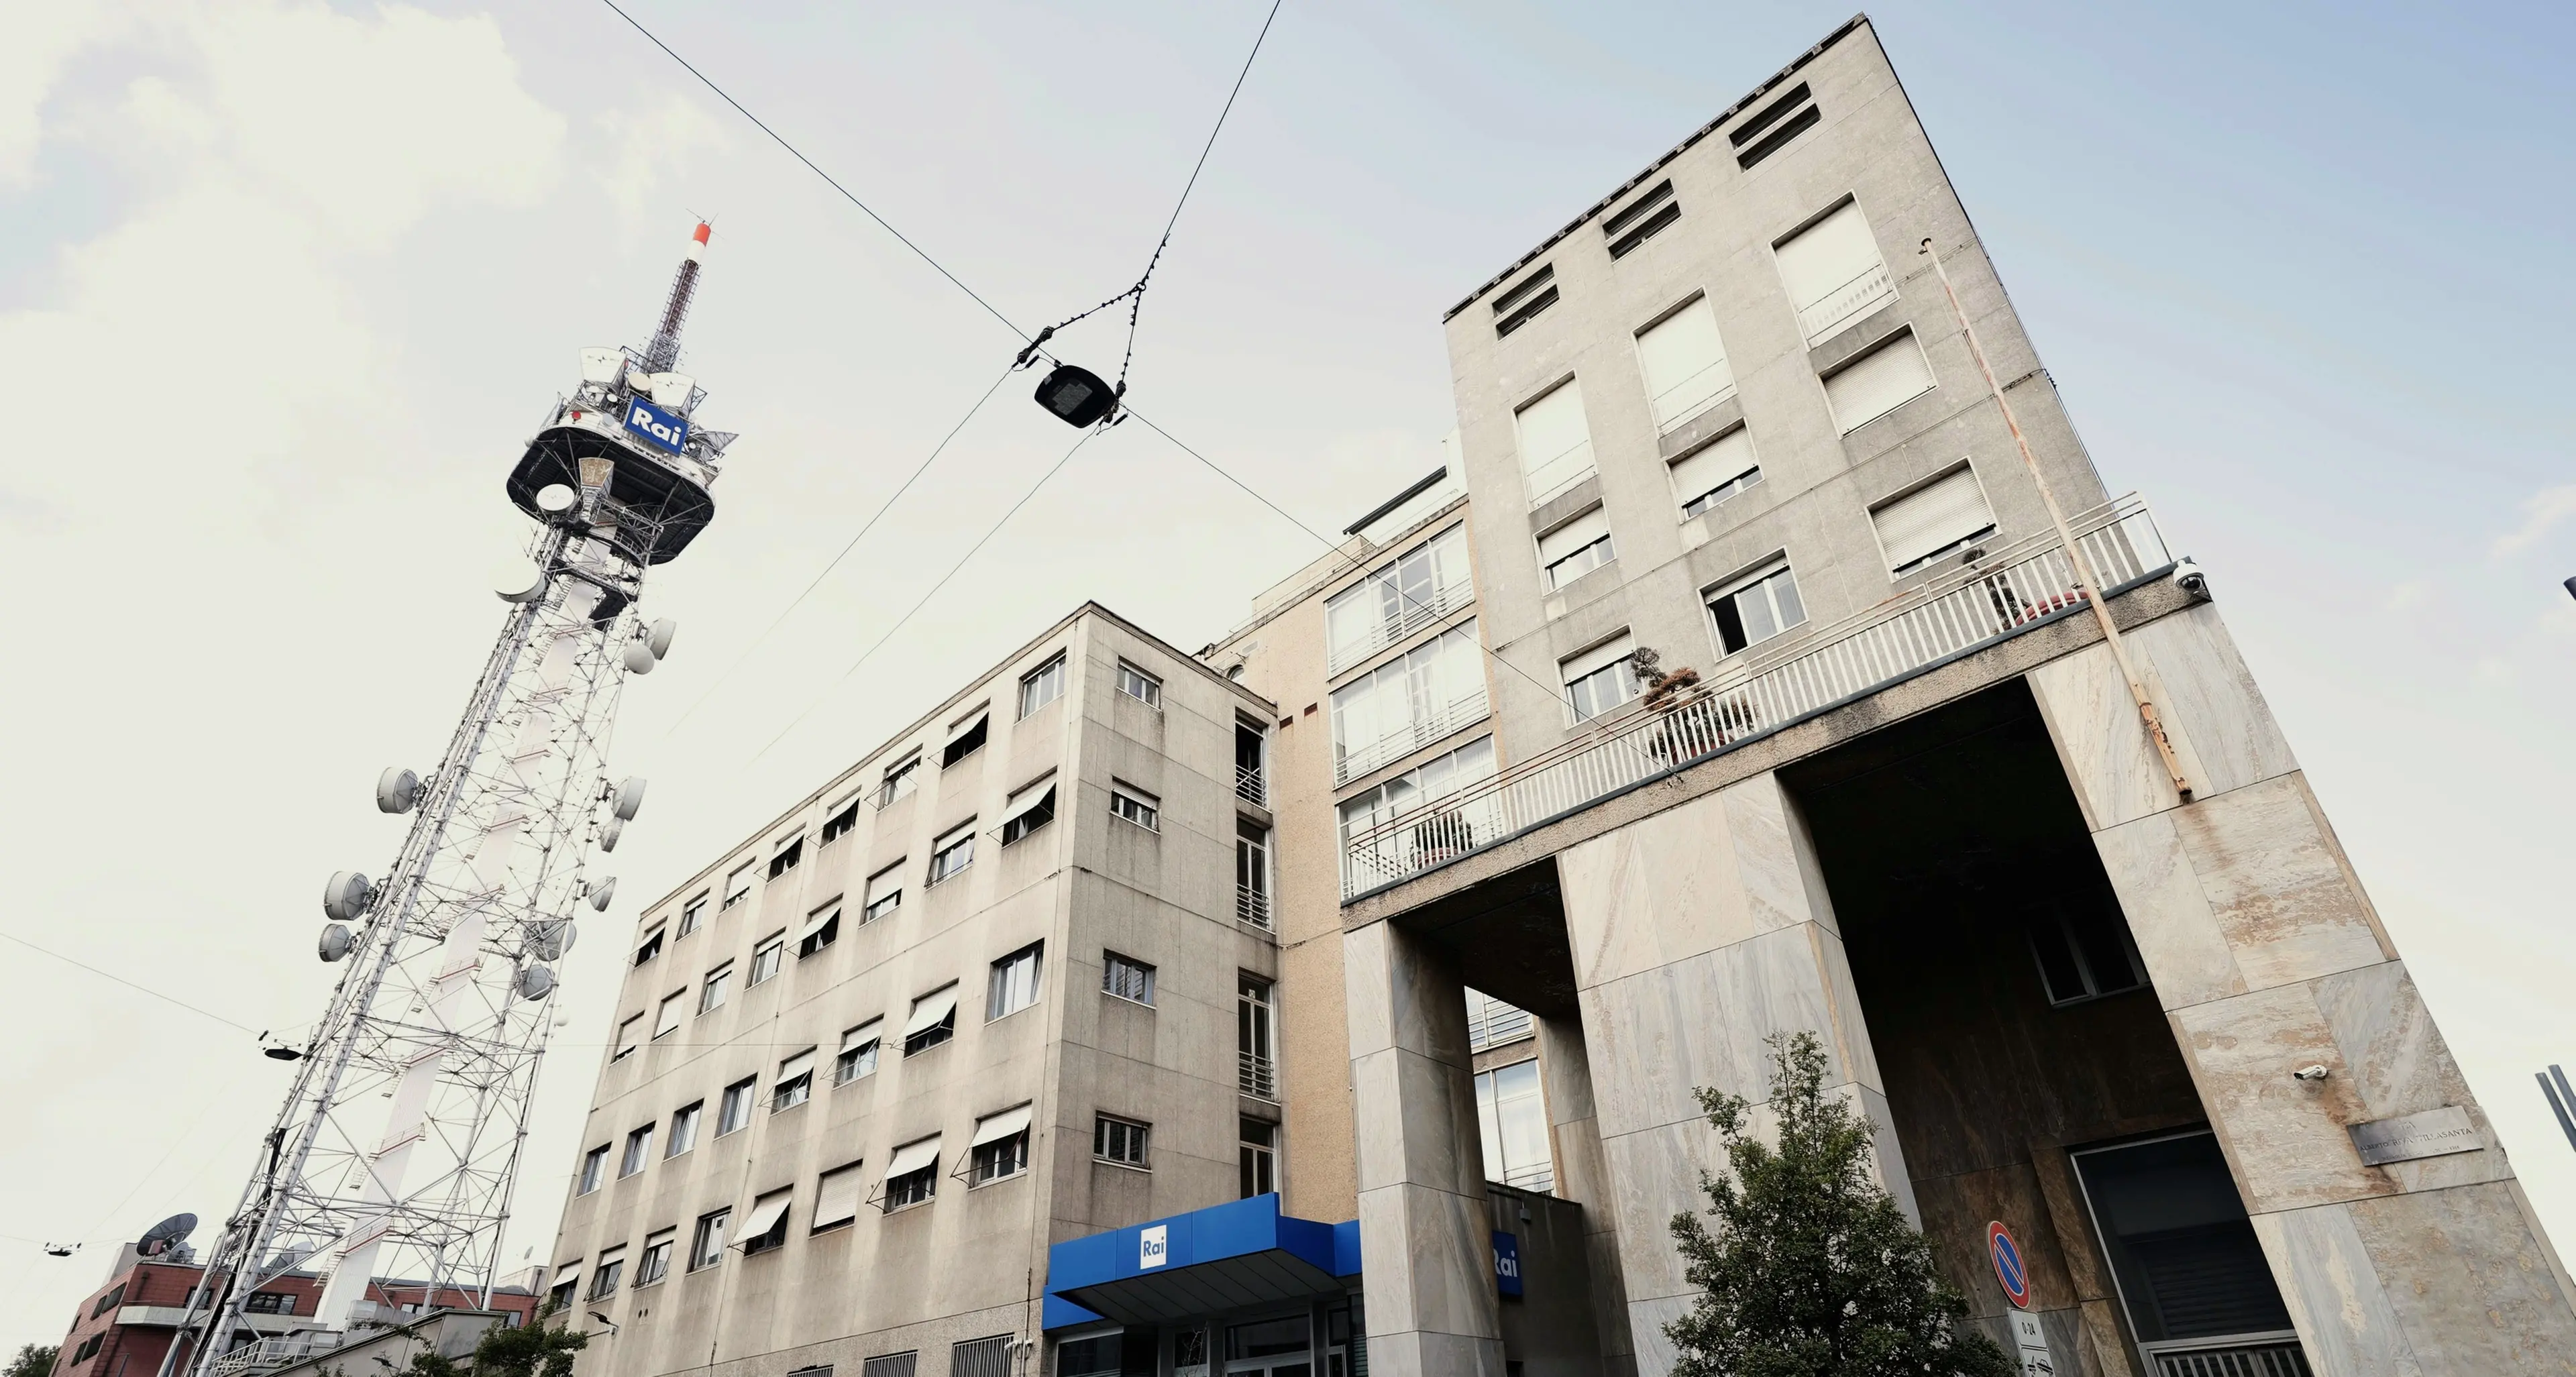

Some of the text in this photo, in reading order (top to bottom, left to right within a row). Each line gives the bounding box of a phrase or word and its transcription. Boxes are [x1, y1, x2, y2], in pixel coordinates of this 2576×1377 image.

[631, 406, 682, 446] Rai
[1143, 1236, 1164, 1258] Rai
[2021, 1322, 2036, 1336] 0-24
